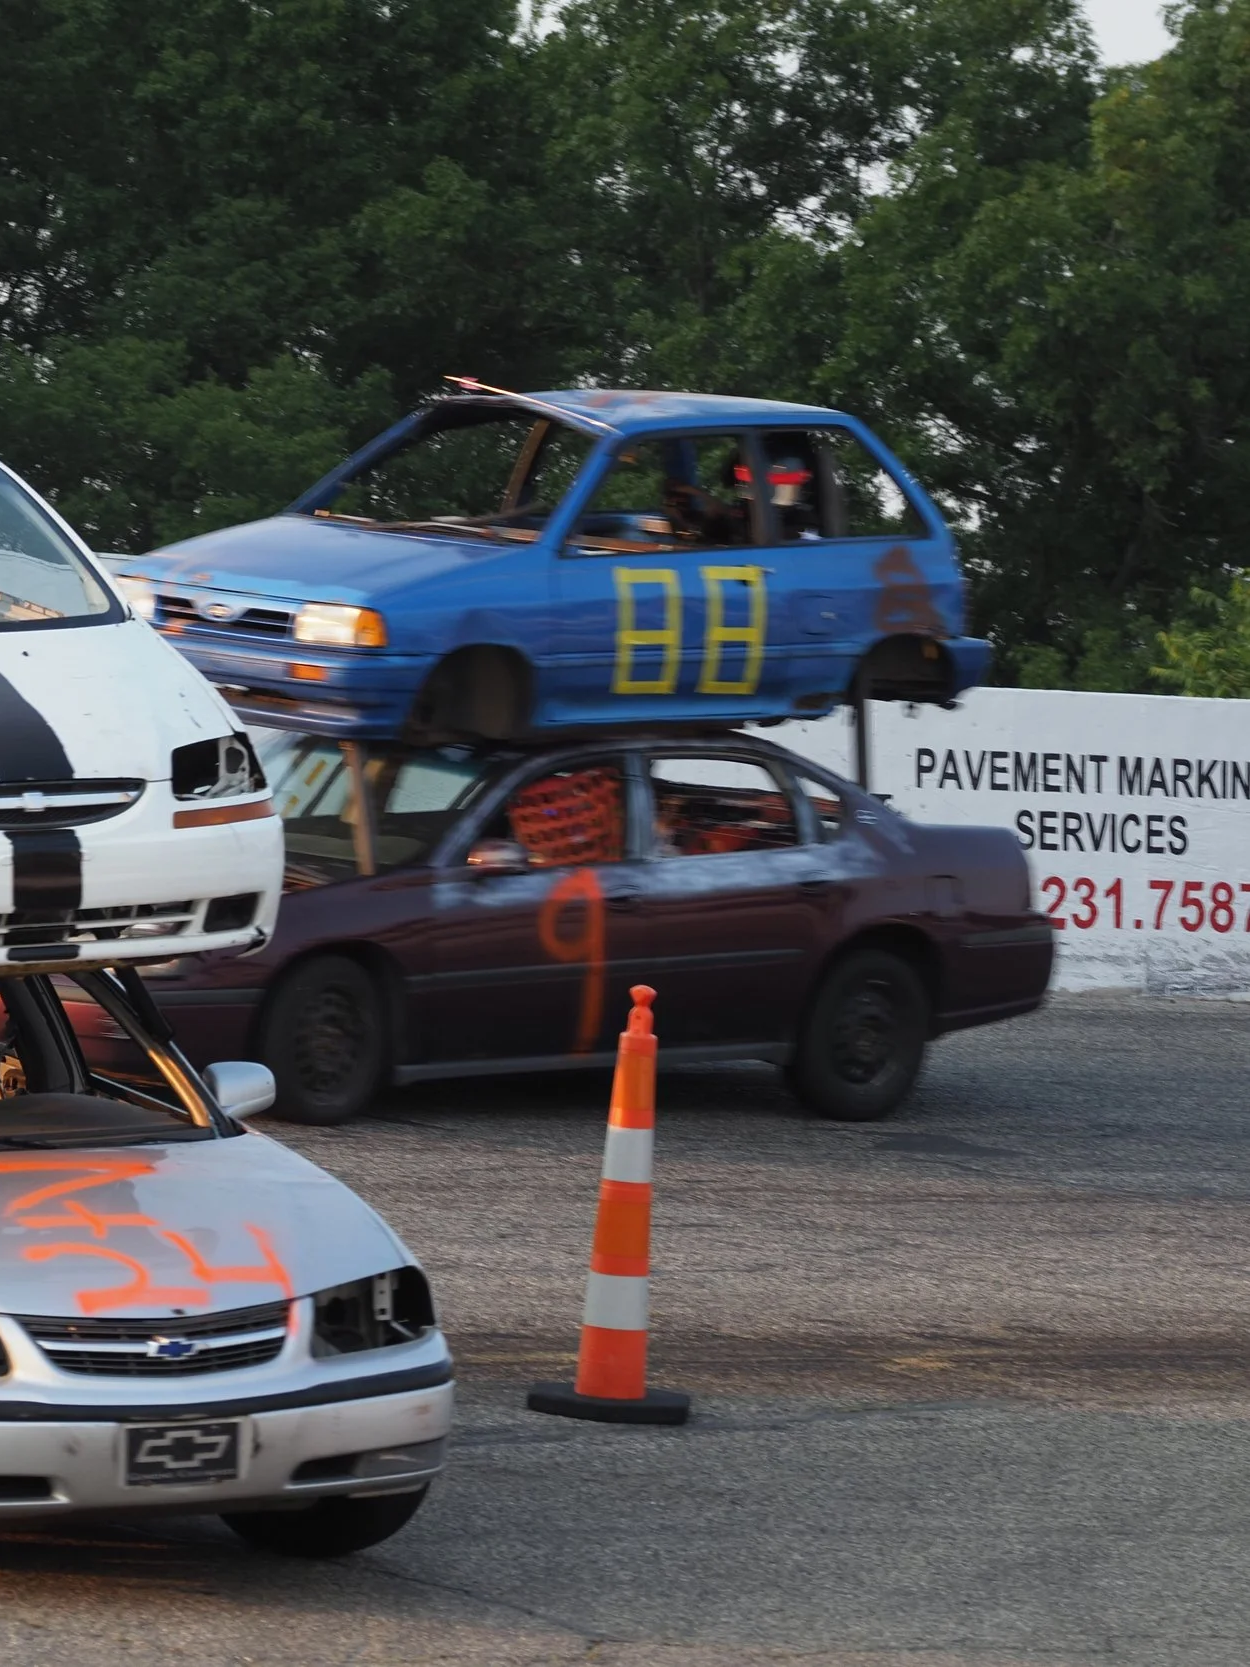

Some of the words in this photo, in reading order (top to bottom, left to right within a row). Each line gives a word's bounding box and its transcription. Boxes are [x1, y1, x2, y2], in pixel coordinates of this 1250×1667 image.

[611, 565, 769, 694] 88
[916, 748, 1109, 795] PAVEMENT
[1118, 755, 1250, 800] MARKIN
[1016, 810, 1189, 855] SERVICES
[538, 868, 607, 1057] 9
